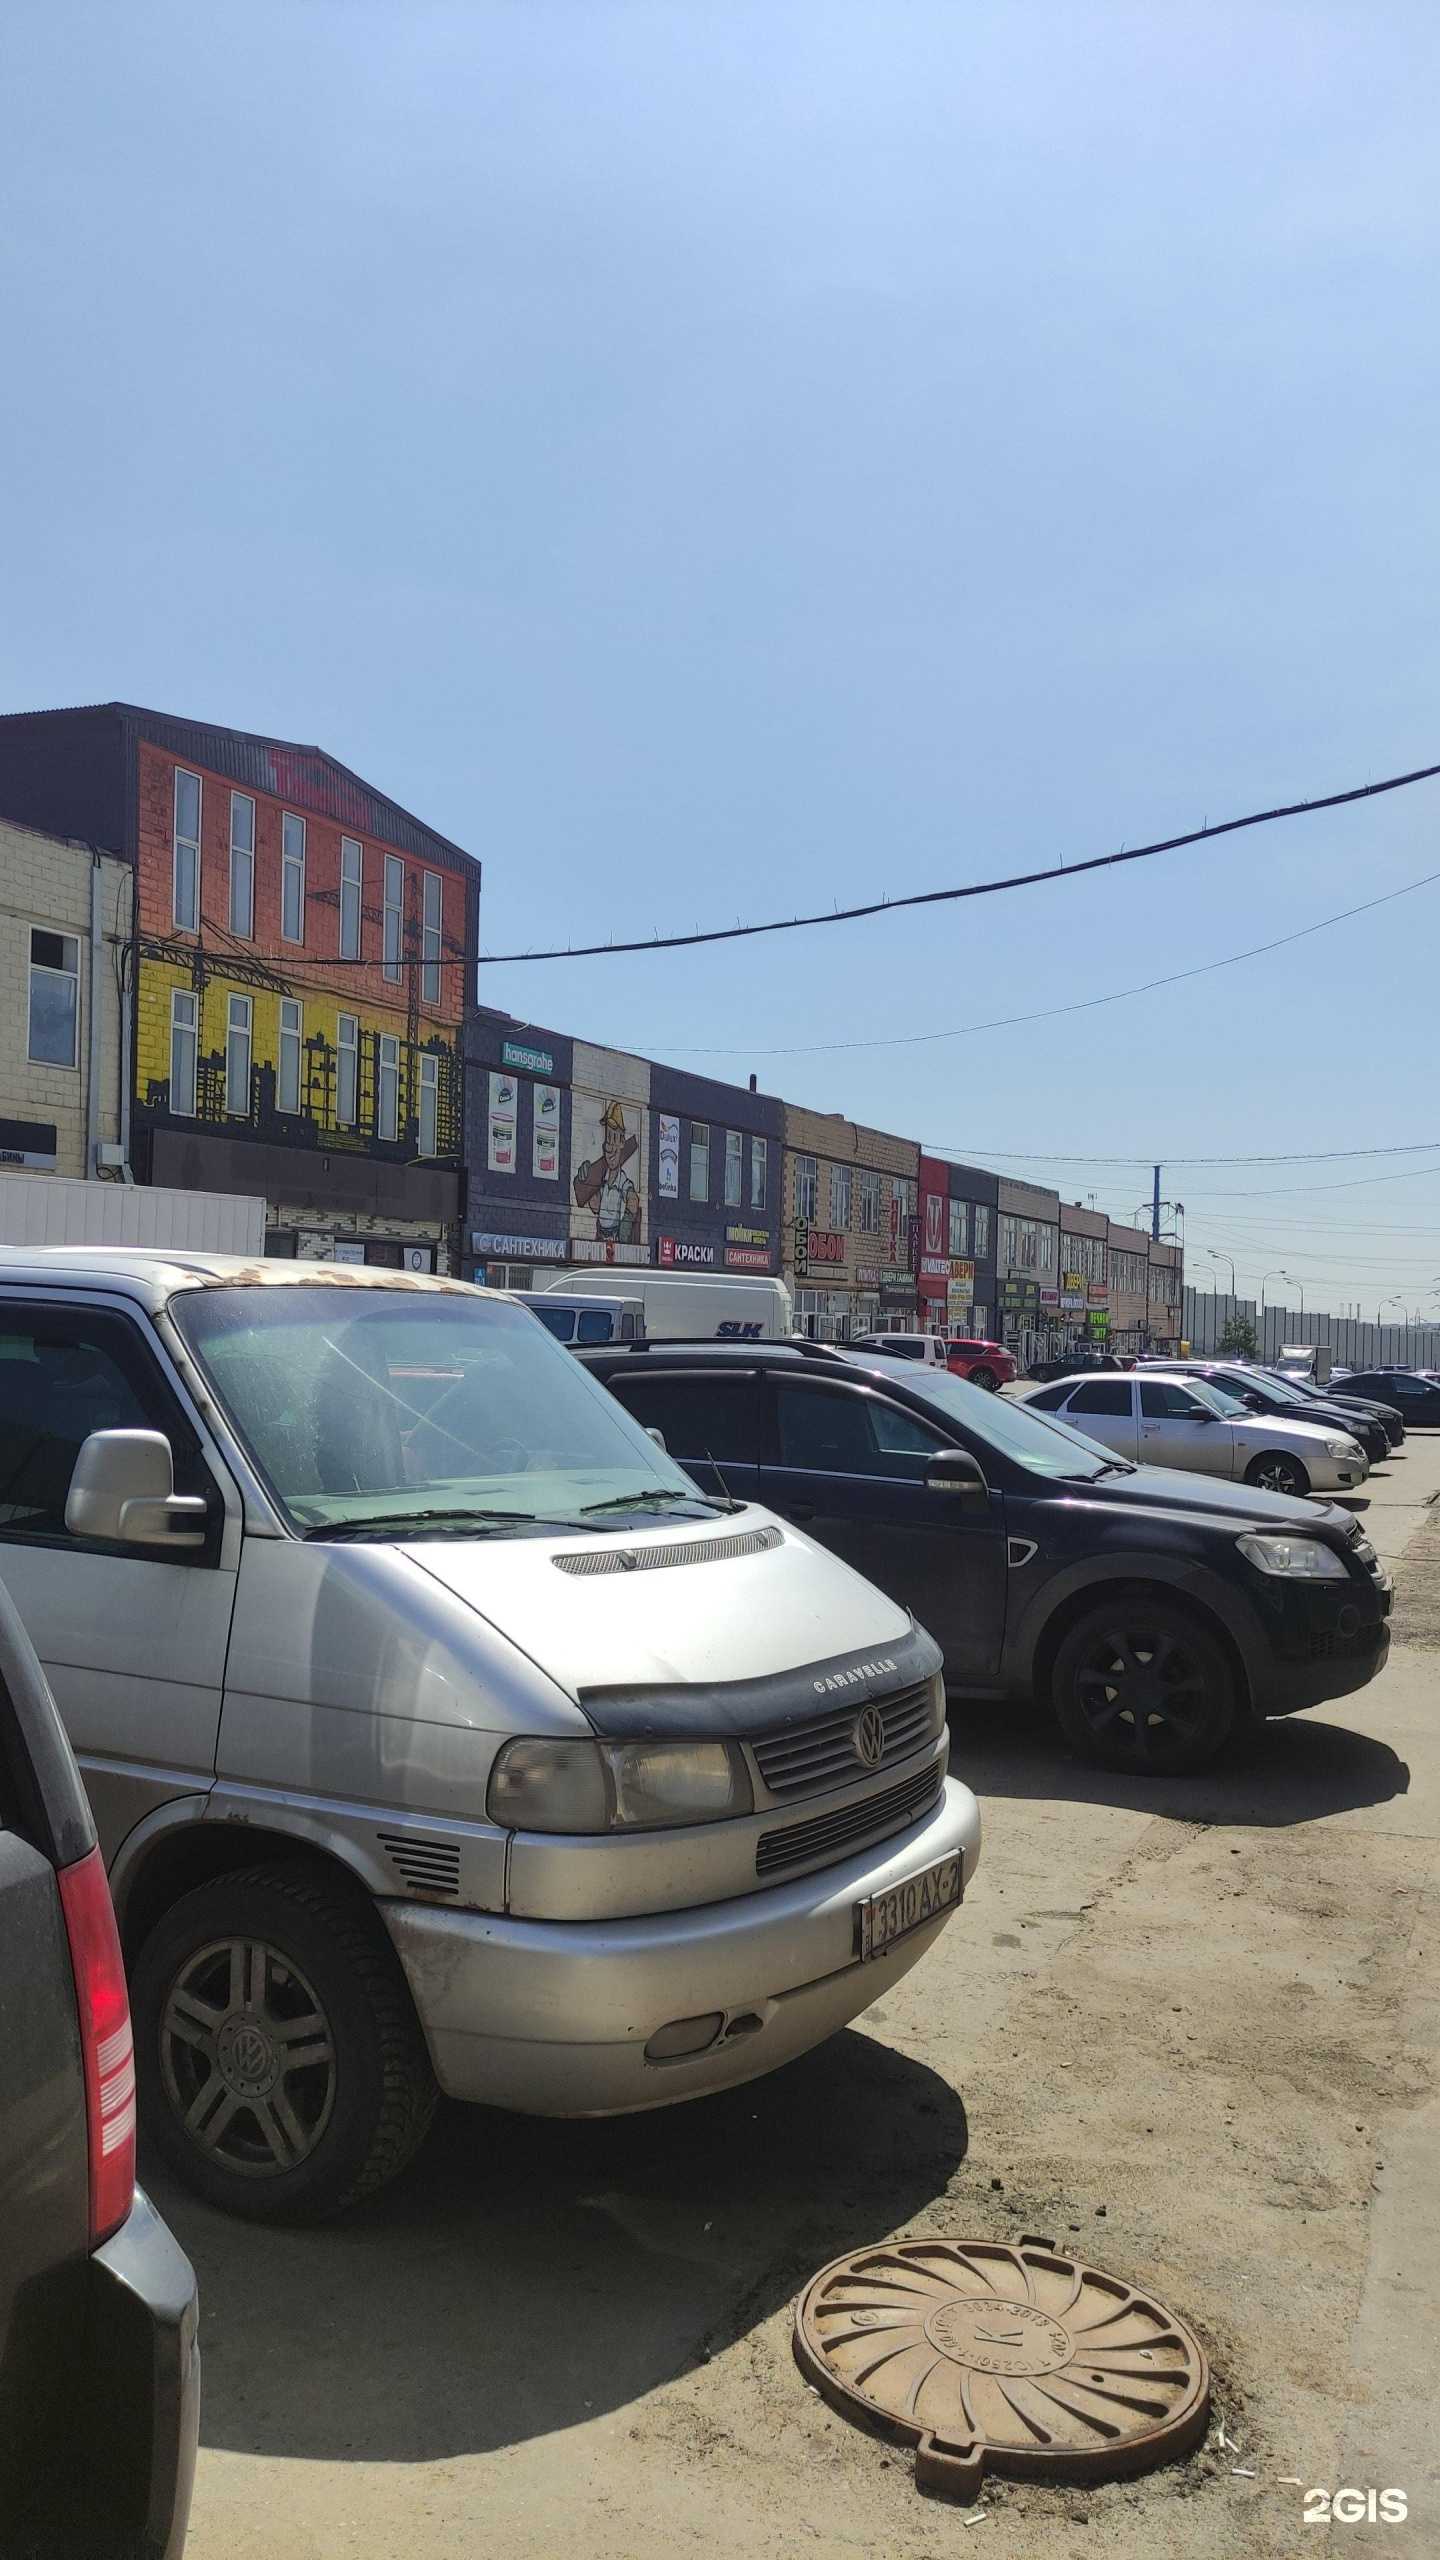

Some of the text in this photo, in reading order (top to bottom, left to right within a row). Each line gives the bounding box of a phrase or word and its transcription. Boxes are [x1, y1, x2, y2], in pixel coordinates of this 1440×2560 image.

[504, 1042, 553, 1071] hansgrohe
[493, 1236, 565, 1258] САНТЕХНИКА
[674, 1243, 714, 1262] КРАСКИ
[729, 1251, 768, 1265] САНТЕХНИКА
[794, 1217, 807, 1274] ОБОИ
[809, 1232, 848, 1260] ОБОИ
[813, 1658, 898, 1694] CARAVELLE
